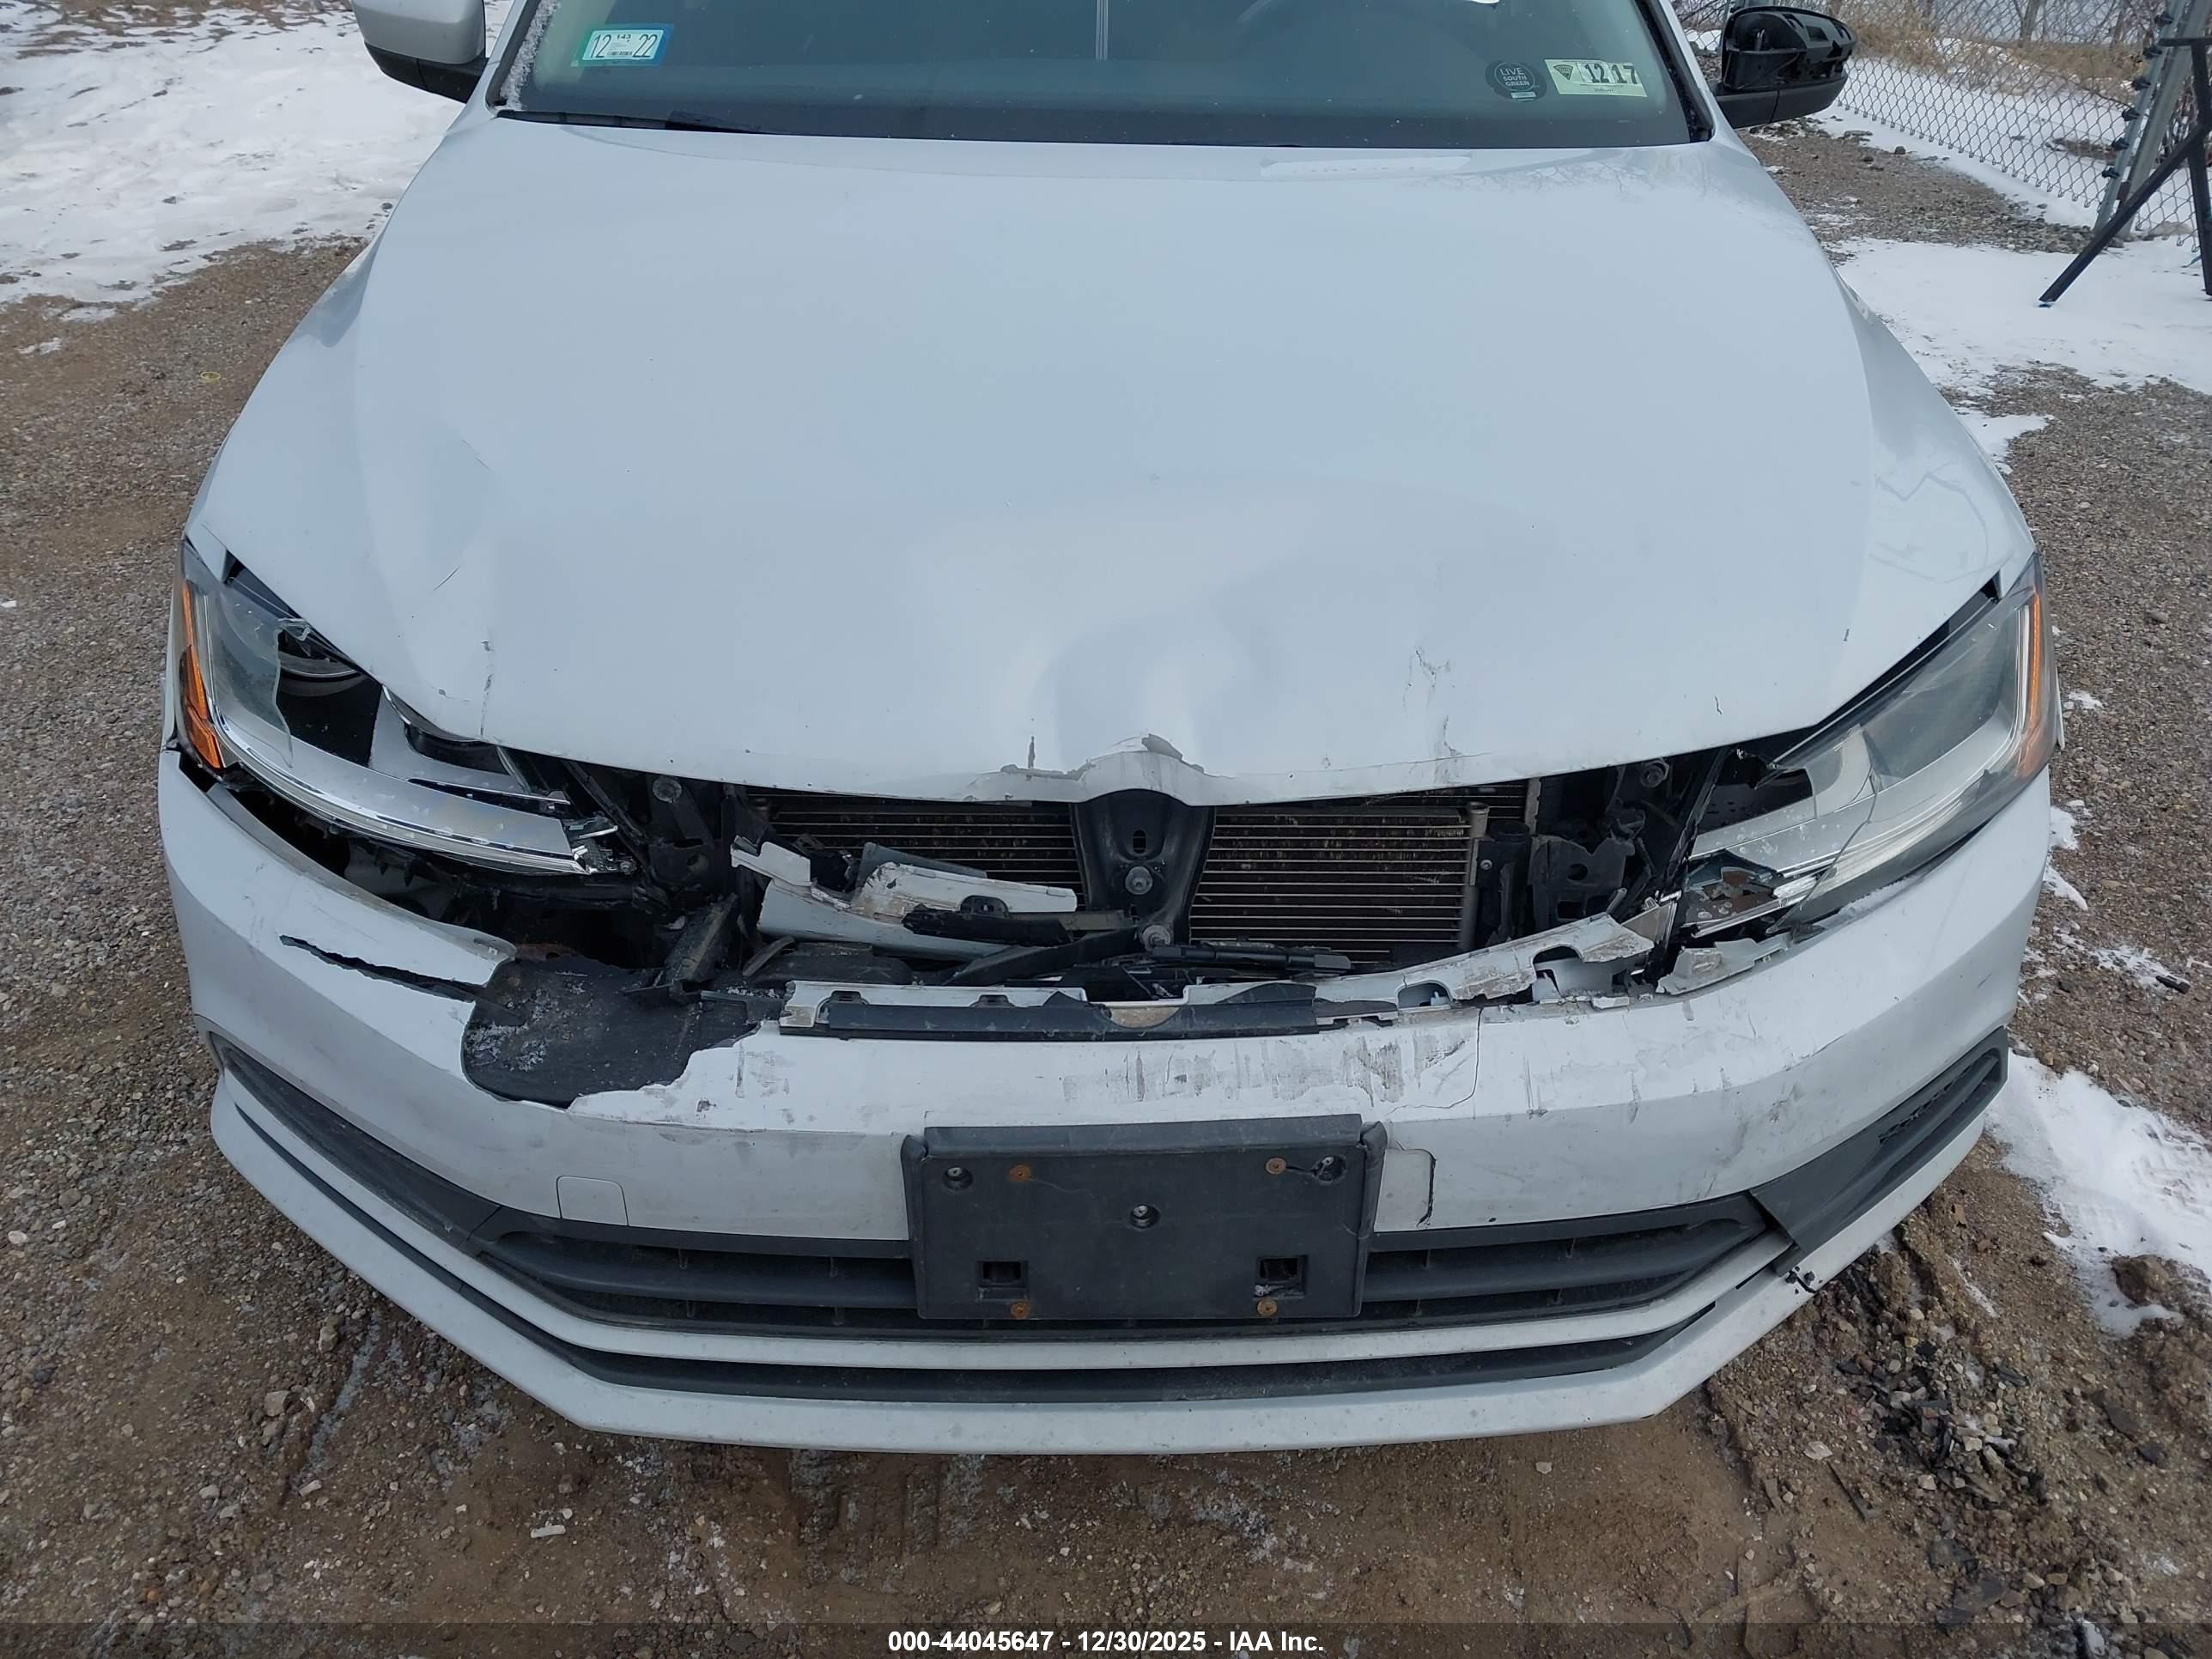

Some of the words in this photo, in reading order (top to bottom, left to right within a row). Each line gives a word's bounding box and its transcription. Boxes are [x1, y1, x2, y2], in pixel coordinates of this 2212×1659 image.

[591, 34, 611, 58] 12
[632, 33, 658, 58] 22
[1499, 67, 1525, 76] LIVE
[1584, 64, 1610, 83] 12
[1612, 64, 1638, 84] 17
